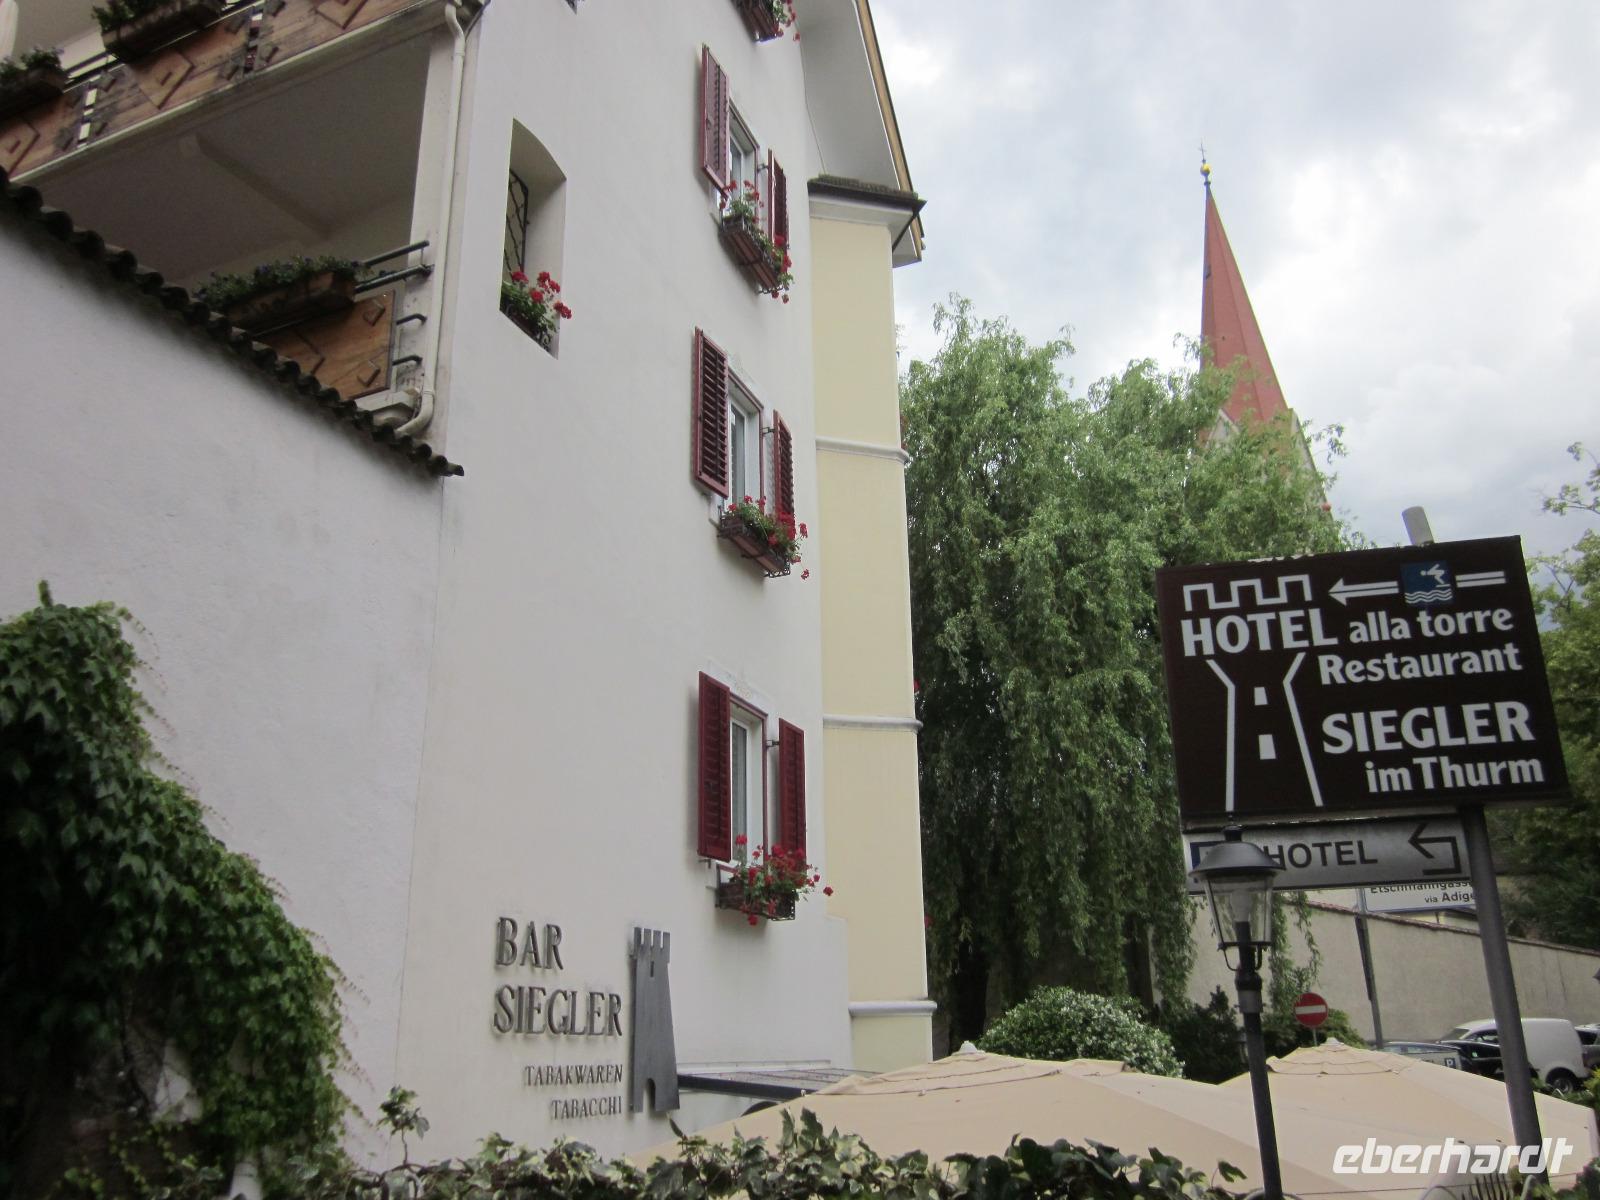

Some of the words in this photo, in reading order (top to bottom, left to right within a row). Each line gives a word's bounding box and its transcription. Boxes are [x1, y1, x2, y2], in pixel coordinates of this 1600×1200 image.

[1181, 608, 1338, 657] HOTEL
[1349, 611, 1411, 644] alla
[1418, 608, 1514, 637] torre
[1318, 643, 1522, 685] Restaurant
[1321, 701, 1536, 754] SIEGLER
[1412, 756, 1545, 790] Thurm
[1263, 840, 1378, 869] HOTEL
[1370, 881, 1473, 894] Etschmanngass
[1424, 894, 1438, 903] via
[1441, 891, 1473, 902] Adig
[495, 916, 564, 970] BAR
[493, 984, 622, 1036] SIEGLER
[524, 1064, 623, 1087] TABAKWAREN
[551, 1096, 622, 1120] TABACCHI
